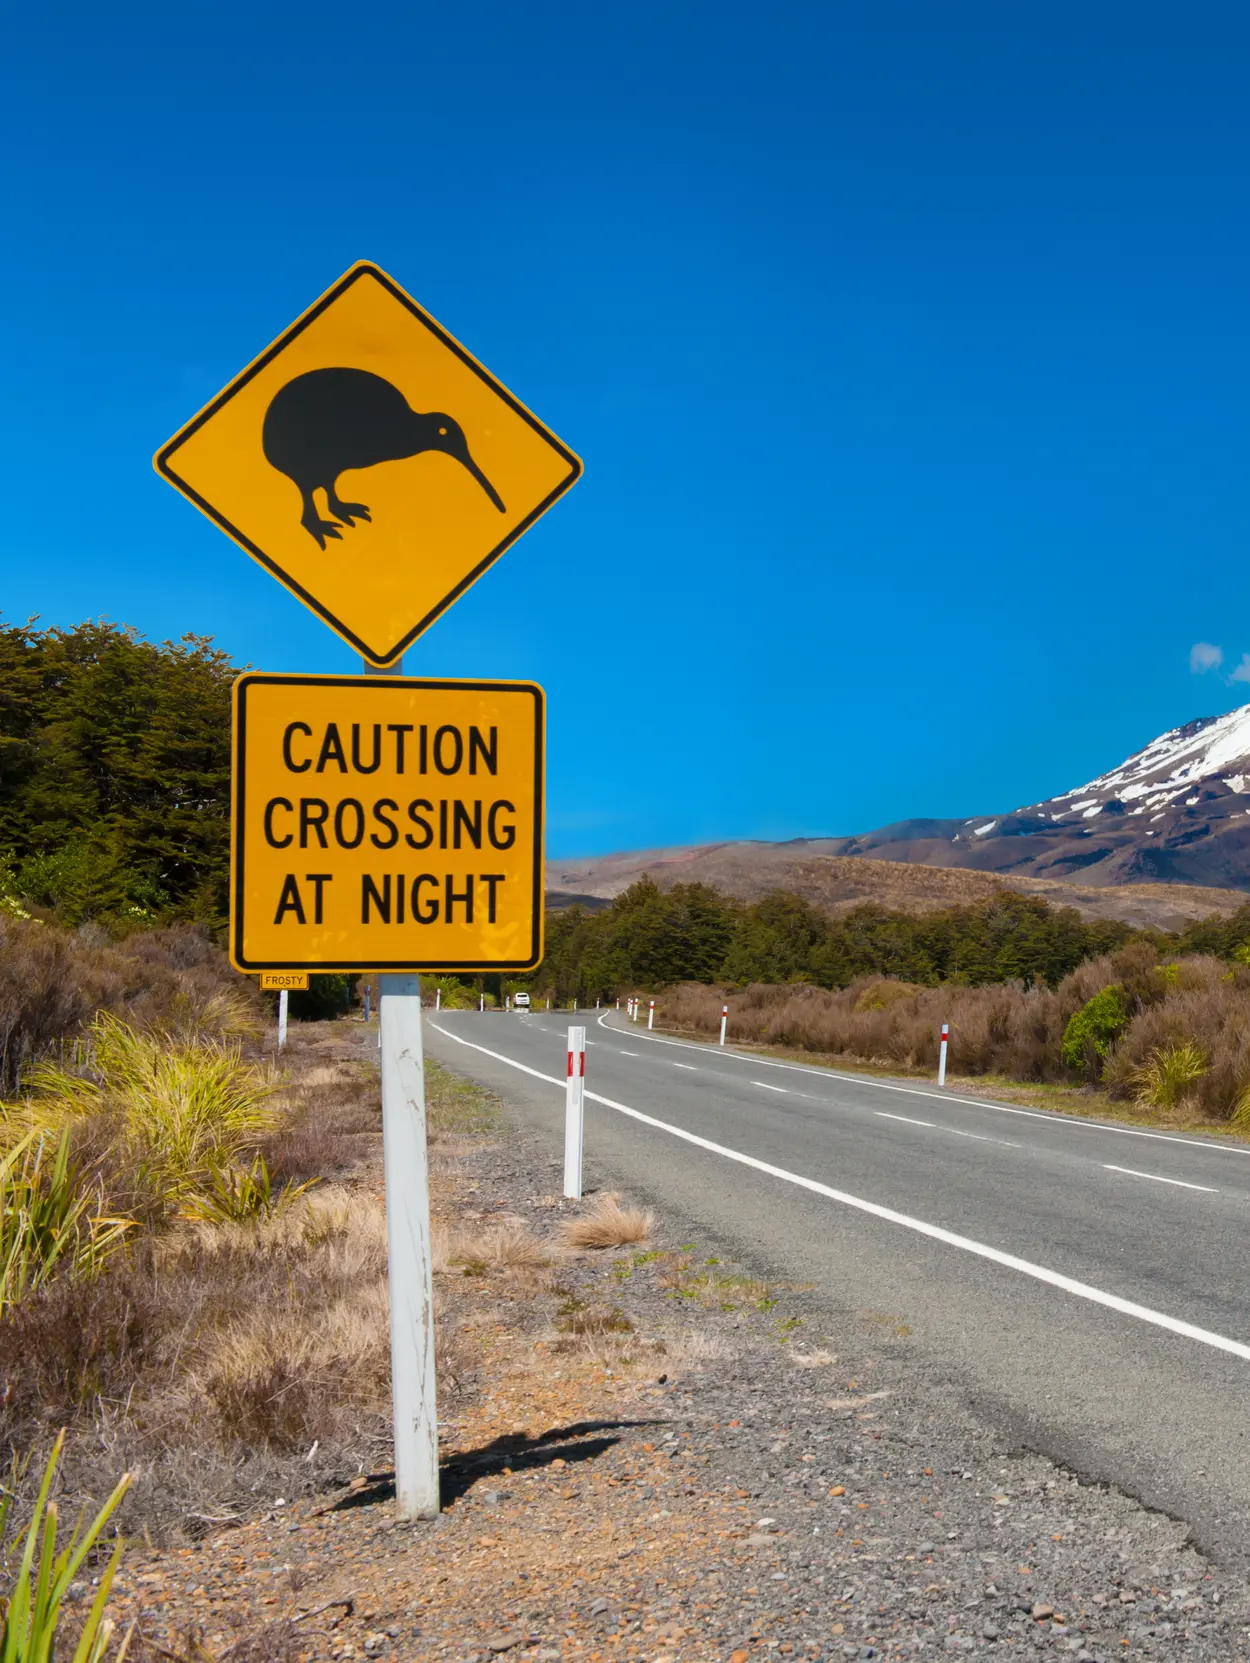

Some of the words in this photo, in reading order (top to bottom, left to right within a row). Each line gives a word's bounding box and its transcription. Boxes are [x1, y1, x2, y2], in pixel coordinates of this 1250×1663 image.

[282, 721, 498, 776] CAUTION
[263, 796, 516, 851] CROSSING
[273, 873, 333, 925] AT
[361, 873, 505, 925] NIGHT
[265, 976, 303, 985] FROSTY
